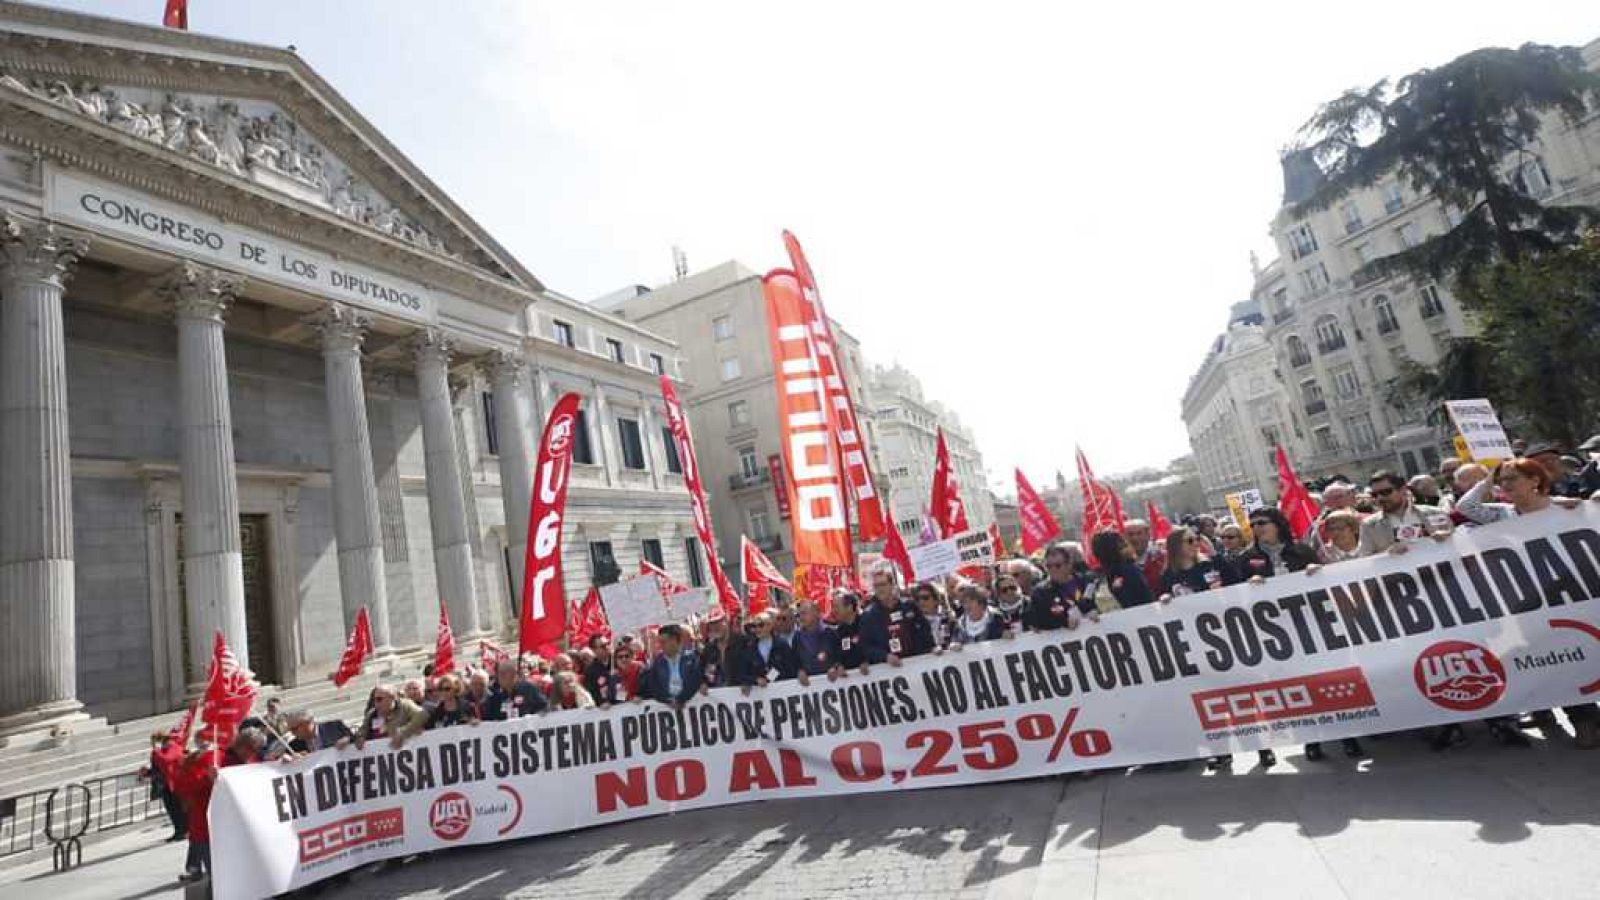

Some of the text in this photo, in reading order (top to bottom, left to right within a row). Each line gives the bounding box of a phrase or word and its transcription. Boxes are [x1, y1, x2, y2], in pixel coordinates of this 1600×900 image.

[80, 192, 422, 311] CONGRESO DE LOS DIPUTADOS
[272, 772, 308, 822] EN
[313, 746, 436, 812] DEFENSA
[440, 736, 487, 786] DEL
[493, 719, 617, 777] SISTEMA
[622, 704, 737, 753] PÚBLICO
[772, 681, 926, 741] PENSIONES.
[922, 665, 969, 715] NO
[972, 657, 1009, 709] AL
[1006, 630, 1140, 700] FACTOR
[1141, 619, 1198, 682] DE
[1198, 528, 1600, 672] SOSTENIBILIDAD
[1422, 648, 1492, 682] UGT
[1514, 646, 1586, 672] Madrid
[1202, 684, 1313, 722] CCOO
[1271, 717, 1317, 733] obreras
[1319, 713, 1334, 725] de
[1335, 707, 1380, 722] Madrid
[596, 707, 1112, 813] NO AL 0,25%
